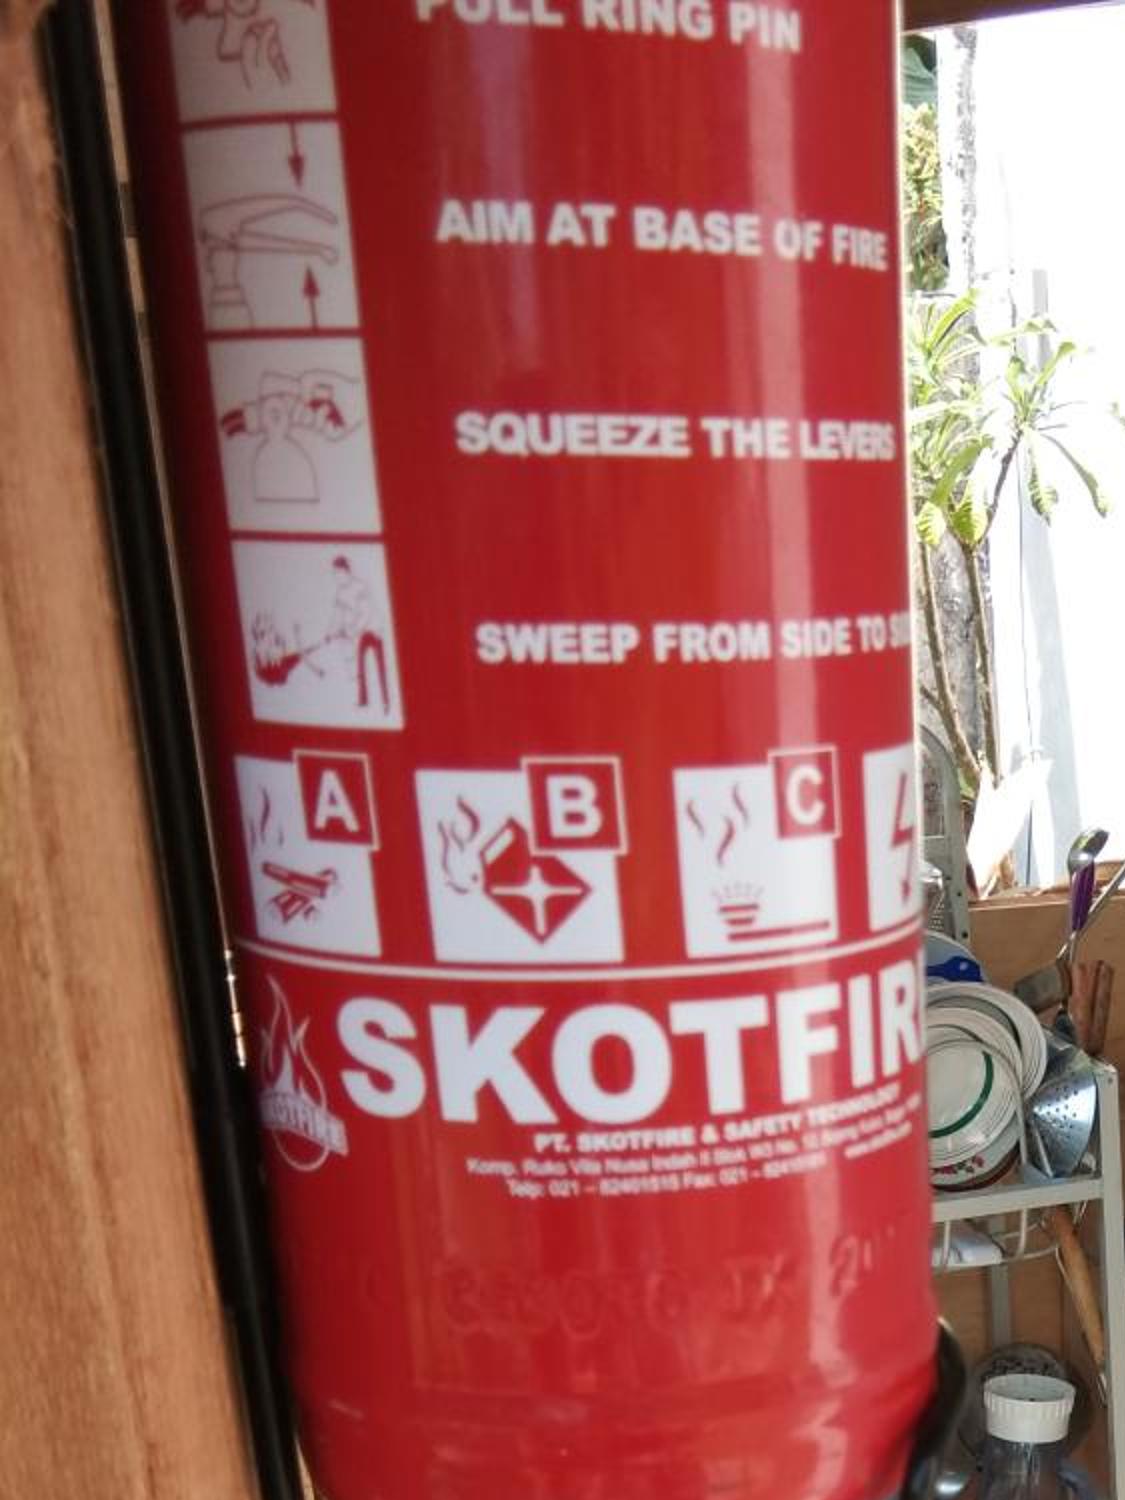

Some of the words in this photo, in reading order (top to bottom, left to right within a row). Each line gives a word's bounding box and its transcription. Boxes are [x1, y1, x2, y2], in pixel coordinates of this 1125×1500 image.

[582, 0, 714, 40] RING
[729, 2, 801, 53] PIN
[437, 201, 532, 245] AIM
[546, 204, 616, 248] AT
[634, 207, 761, 257] BASE
[774, 217, 823, 261] OF
[832, 225, 888, 271] FIRE
[455, 411, 691, 458] SQUEEZE
[701, 418, 792, 459] THE
[800, 422, 896, 461] LEVERS
[476, 623, 639, 664] SWEEP
[653, 623, 770, 663] FROM
[782, 617, 851, 659] SIDE
[857, 614, 886, 652] TO
[314, 770, 358, 831] A
[546, 774, 603, 838] B
[784, 765, 825, 827] C
[336, 945, 926, 1125] SKOTFIR
[577, 1126, 695, 1153] SKOTFIRE
[702, 1122, 720, 1144] &
[724, 1111, 801, 1141] SAFETY
